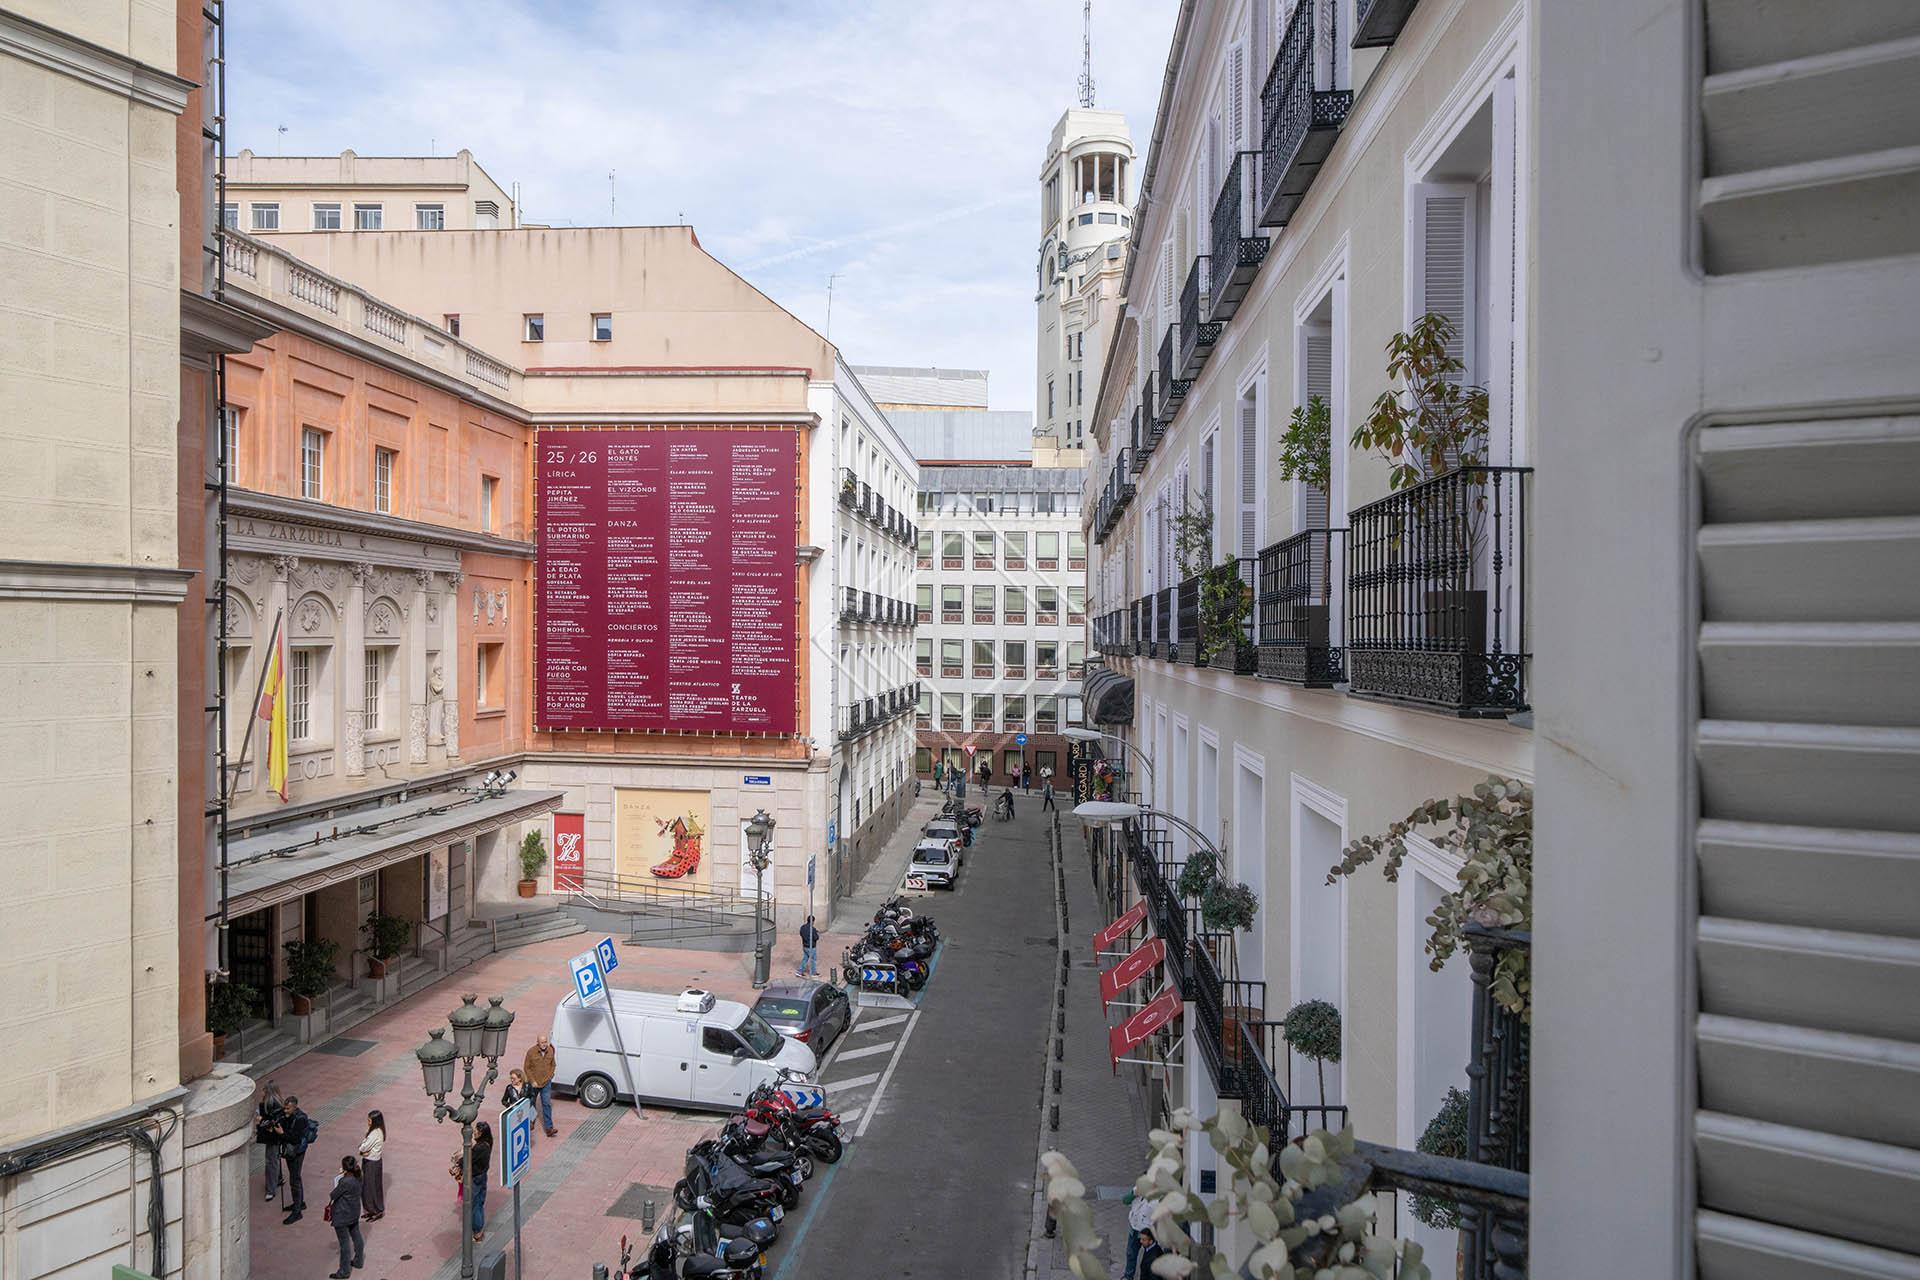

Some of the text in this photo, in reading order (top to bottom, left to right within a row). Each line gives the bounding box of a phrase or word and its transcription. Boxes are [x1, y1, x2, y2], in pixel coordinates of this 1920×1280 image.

[547, 451, 597, 465] 25 / 26
[547, 470, 576, 478] LÍRICA
[235, 519, 343, 547] LA ZARZUELA
[1078, 763, 1088, 804] SAGARDI
[600, 943, 612, 971] P
[578, 968, 594, 995] P
[513, 1127, 526, 1168] P
